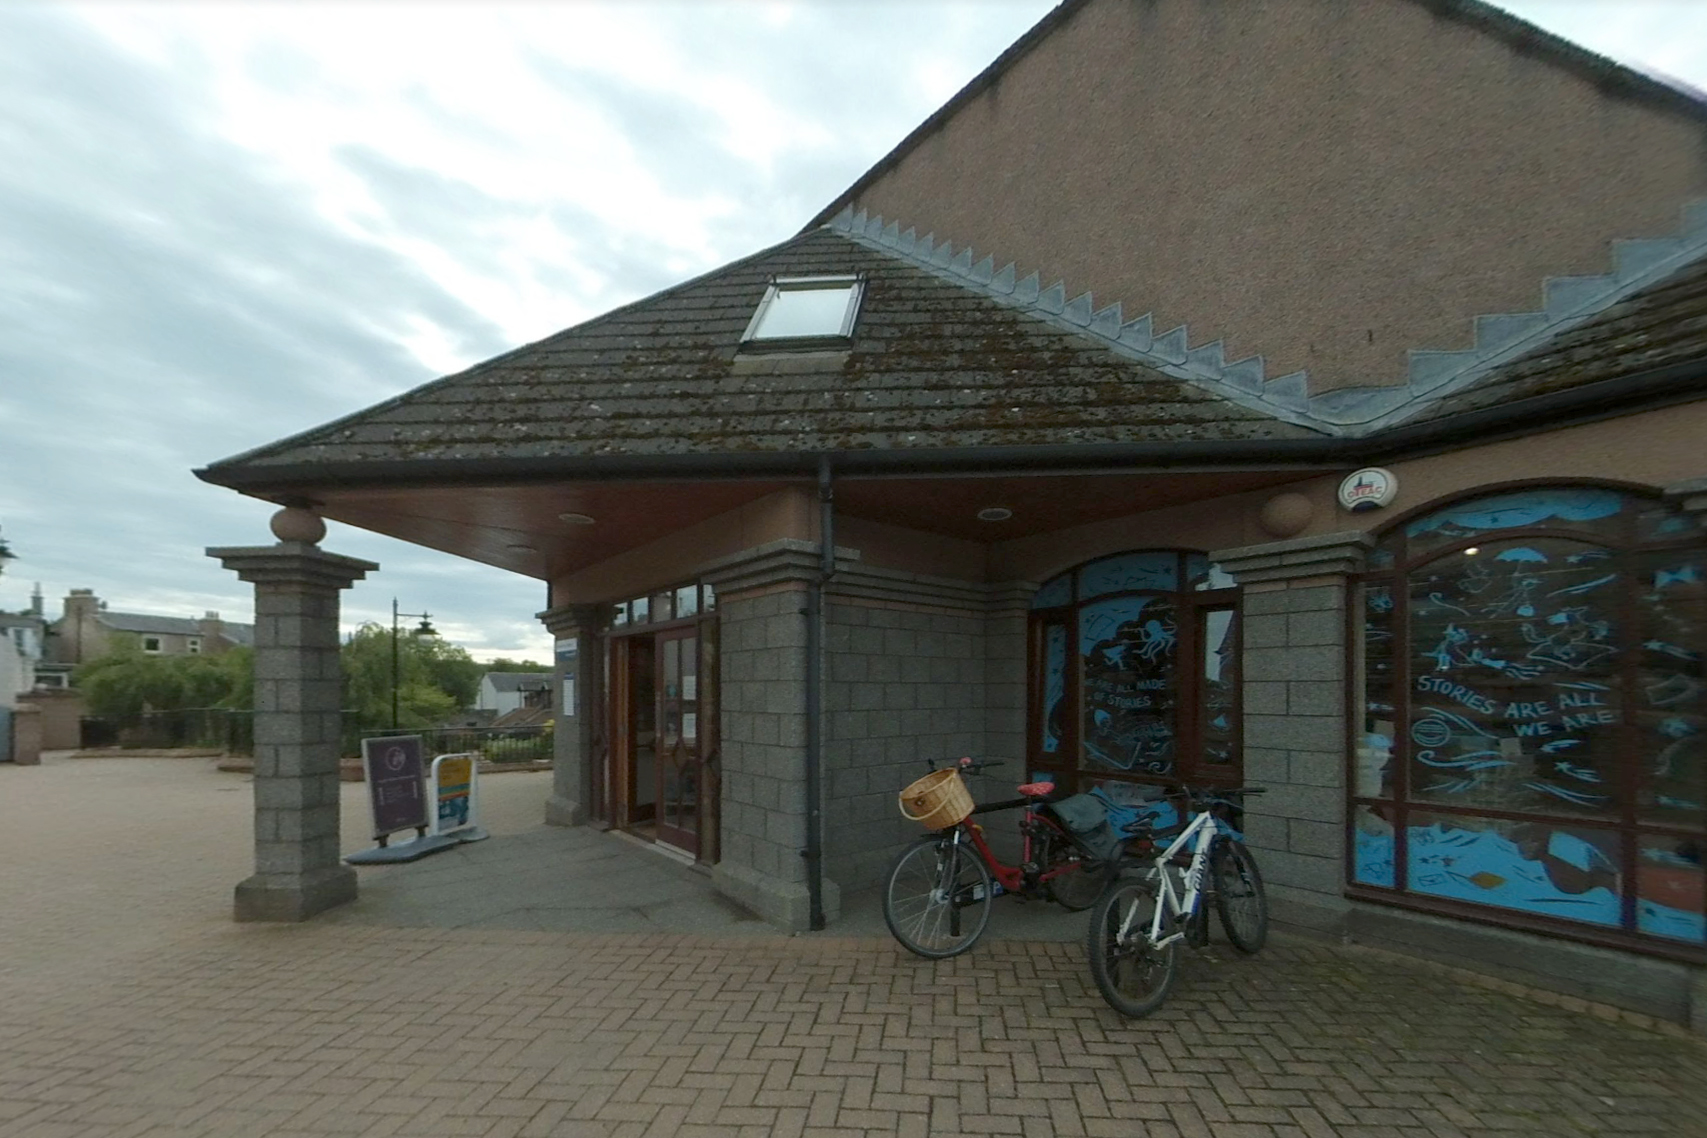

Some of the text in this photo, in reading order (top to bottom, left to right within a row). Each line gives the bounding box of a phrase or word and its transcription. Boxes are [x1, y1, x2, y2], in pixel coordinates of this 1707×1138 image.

[1116, 685, 1134, 693] ALL
[1136, 679, 1166, 690] MADE
[1107, 694, 1152, 708] STORIES
[1417, 675, 1608, 718] STORIES ARE ALL
[1513, 710, 1616, 737] WE ARE
